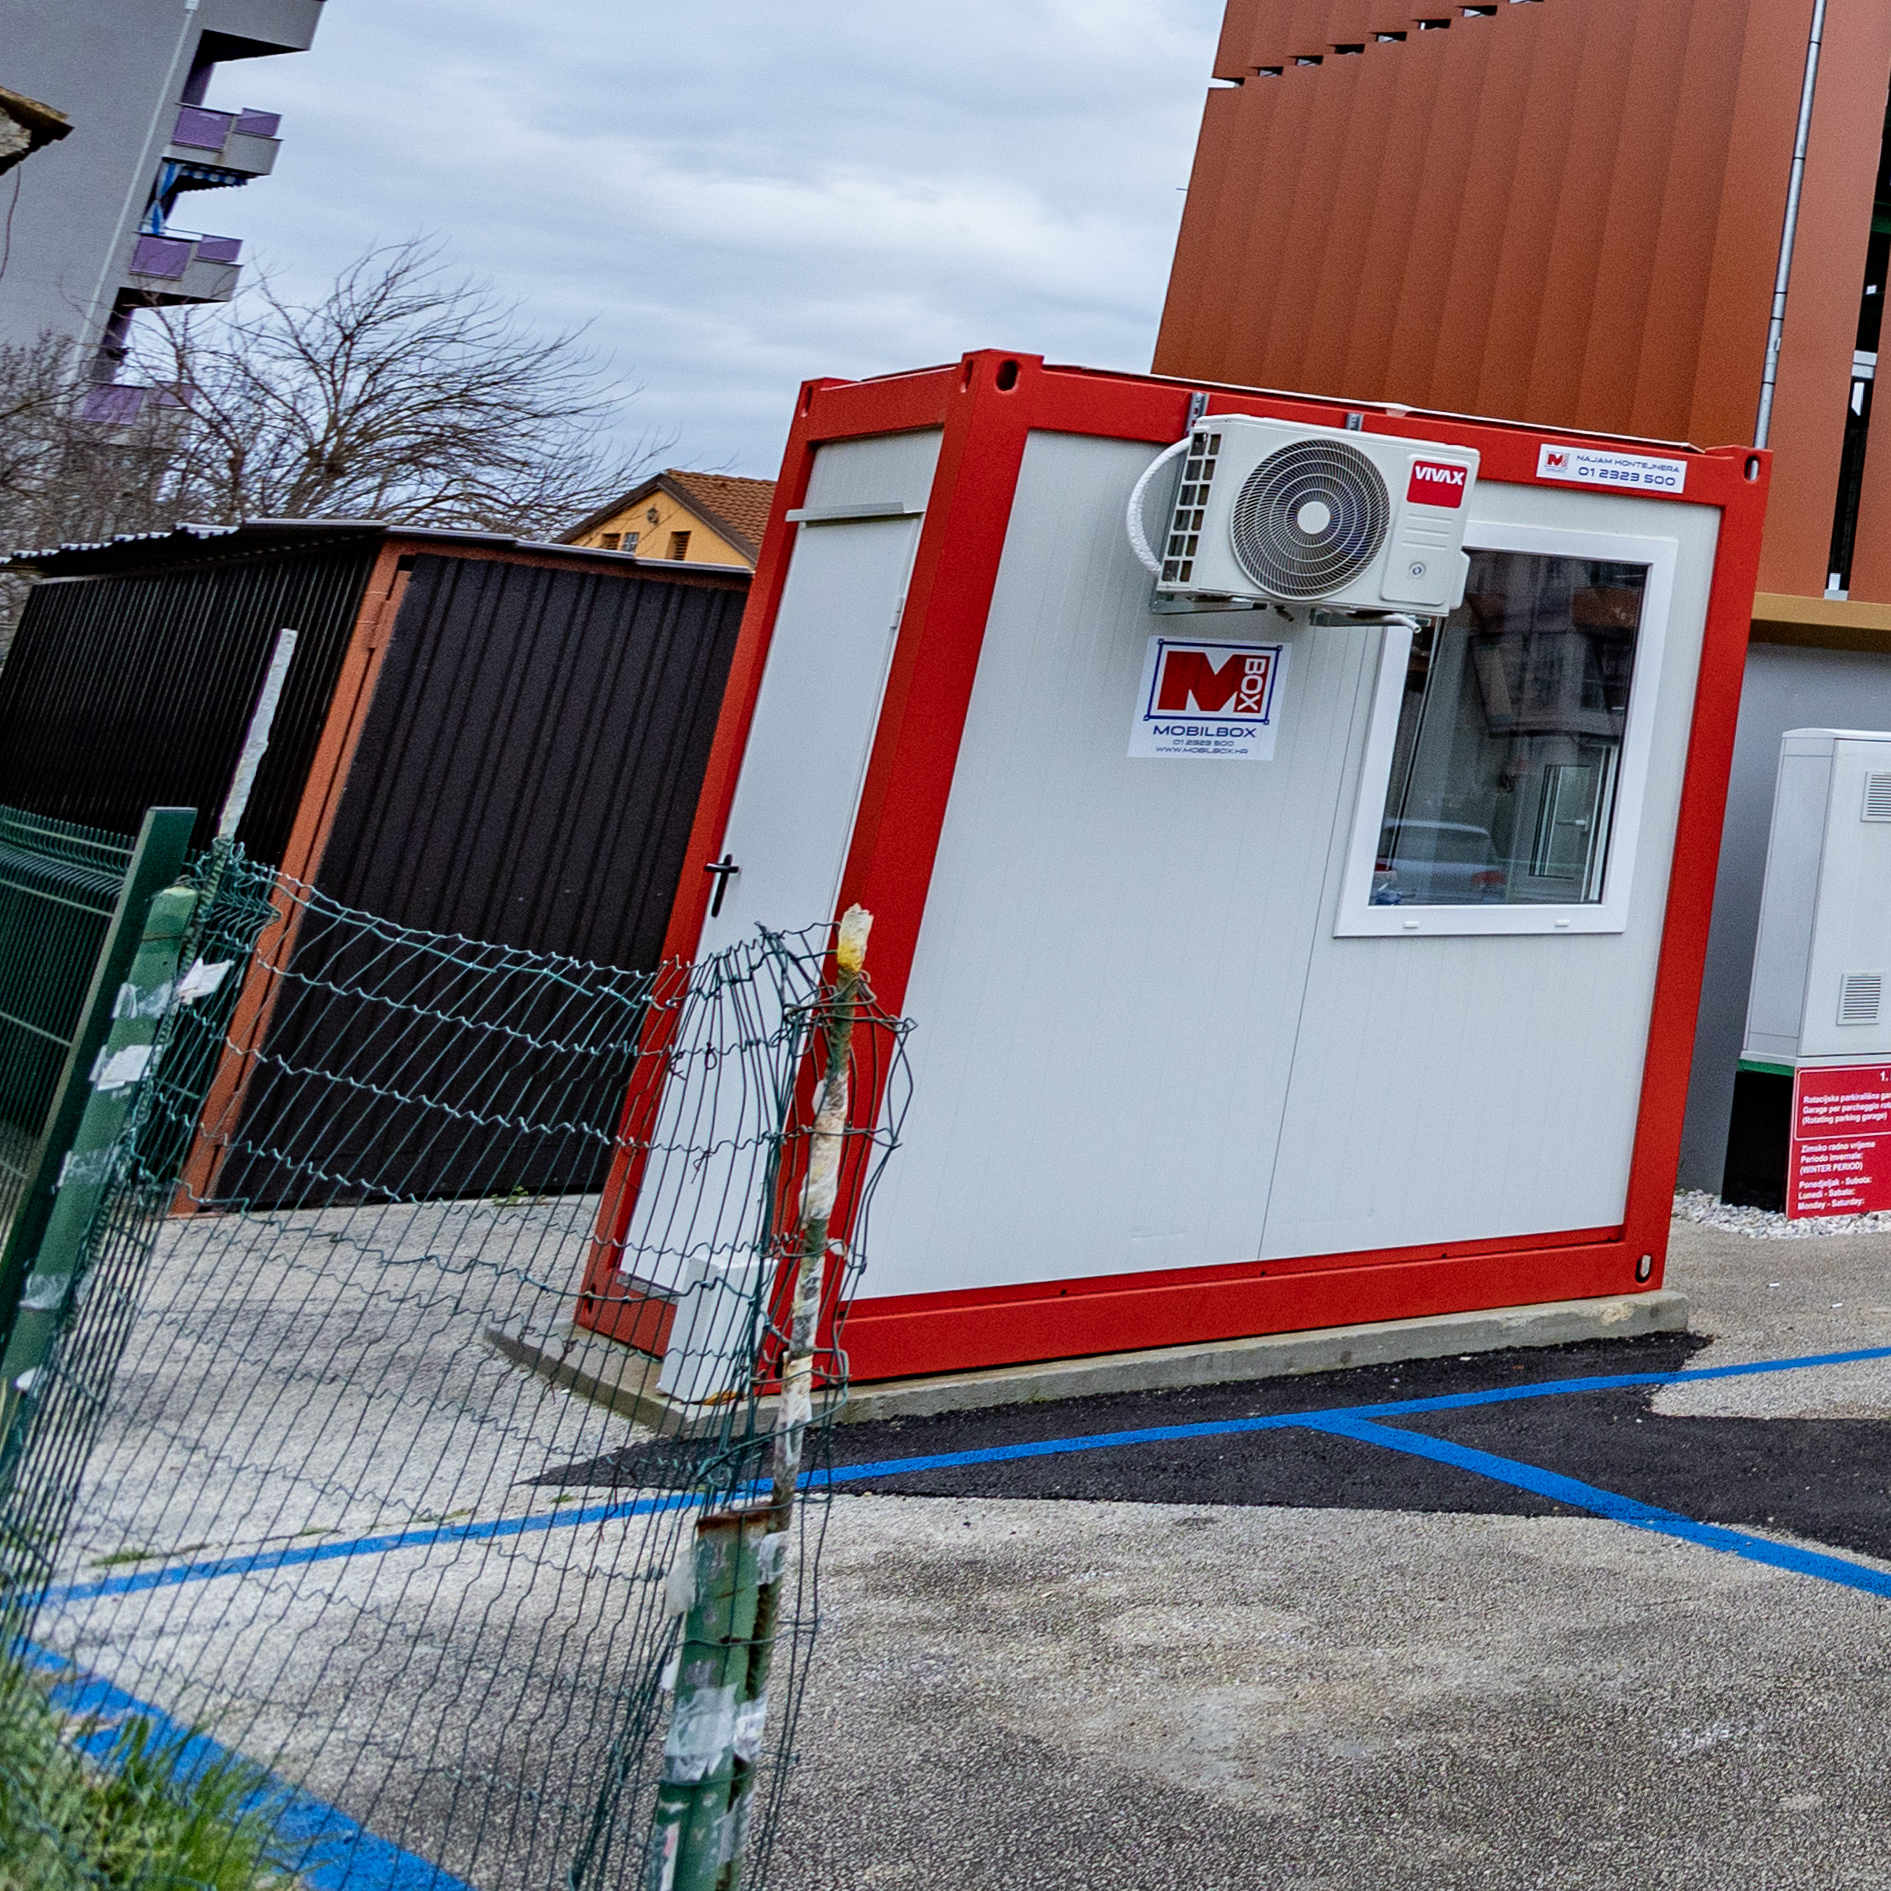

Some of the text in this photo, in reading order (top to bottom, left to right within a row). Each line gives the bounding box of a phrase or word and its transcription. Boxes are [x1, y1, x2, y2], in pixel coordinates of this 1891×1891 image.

[1576, 455, 1613, 466] NAJAM
[1614, 459, 1681, 473] KONTEJNERA
[1415, 465, 1464, 486] VIVAX
[1578, 466, 1596, 477] 01
[1598, 469, 1641, 482] 2323
[1643, 474, 1676, 486] 500
[1236, 657, 1268, 712] BOX
[1153, 725, 1257, 739] MOBILBOX
[1172, 738, 1235, 747] 01 2323 500
[1155, 746, 1249, 755] WWW.MOBILBOX.HR
[1880, 1070, 1889, 1082] 1.
[1803, 1095, 1839, 1104] Rotacijska
[1802, 1105, 1827, 1115] Garage
[1828, 1105, 1841, 1114] per
[1841, 1102, 1880, 1113] parcheggio
[1802, 1111, 1888, 1126] (Rotating parking garage)
[1801, 1141, 1876, 1153] Zimsko radno vrijeme
[1801, 1154, 1829, 1164] Periodo
[1800, 1161, 1864, 1176] (WINTER PERIOD)
[1799, 1177, 1840, 1189] Ponedjeljak
[1845, 1176, 1873, 1186] Subota:
[1797, 1200, 1827, 1211] Monday
[1831, 1197, 1866, 1208] Saturday:
